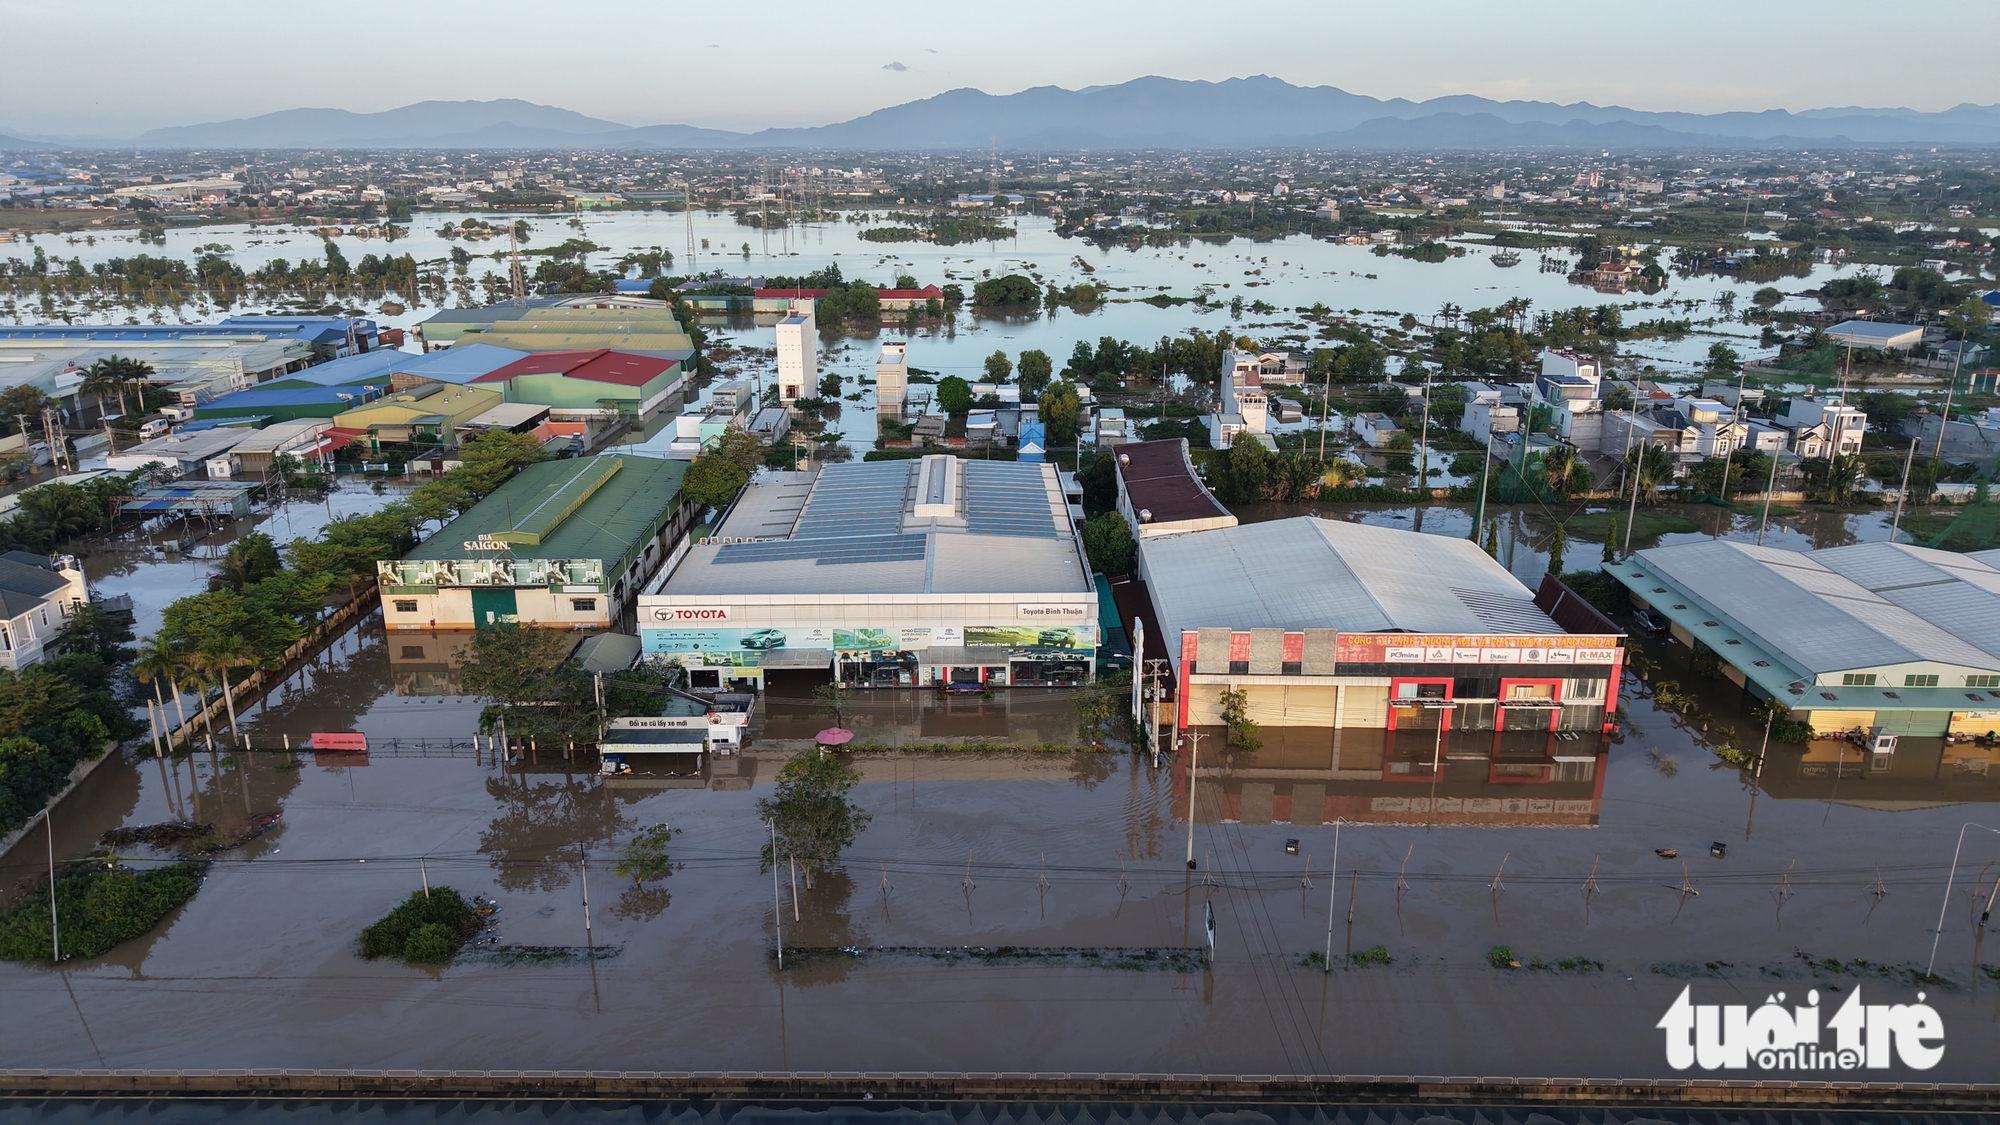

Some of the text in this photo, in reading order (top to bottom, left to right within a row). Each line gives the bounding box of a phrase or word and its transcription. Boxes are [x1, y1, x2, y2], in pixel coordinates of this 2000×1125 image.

[676, 610, 726, 619] TOYOTA
[1023, 608, 1044, 616] Toyota
[1062, 608, 1083, 616] Thuận
